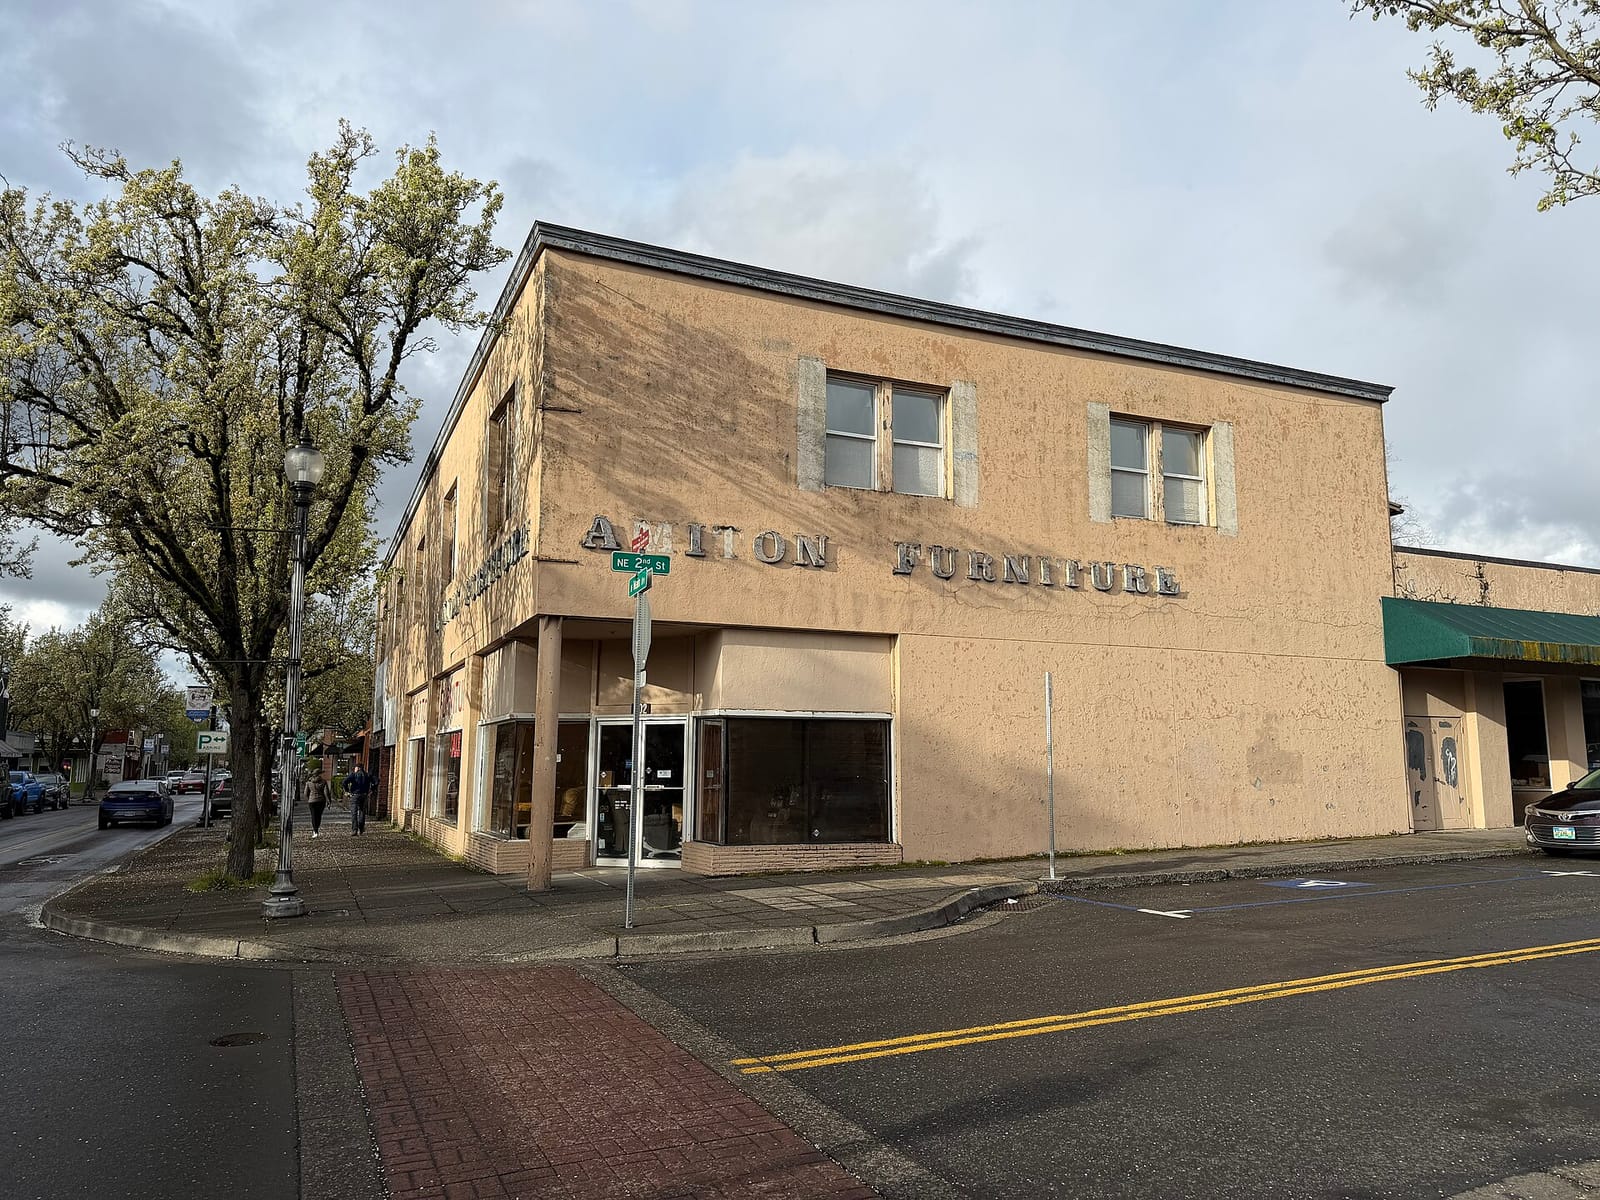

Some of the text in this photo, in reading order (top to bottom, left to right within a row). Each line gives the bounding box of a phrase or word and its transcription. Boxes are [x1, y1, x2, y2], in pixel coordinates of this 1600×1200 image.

[617, 557, 666, 571] NE 2nd St
[893, 541, 1180, 595] FURNITURE
